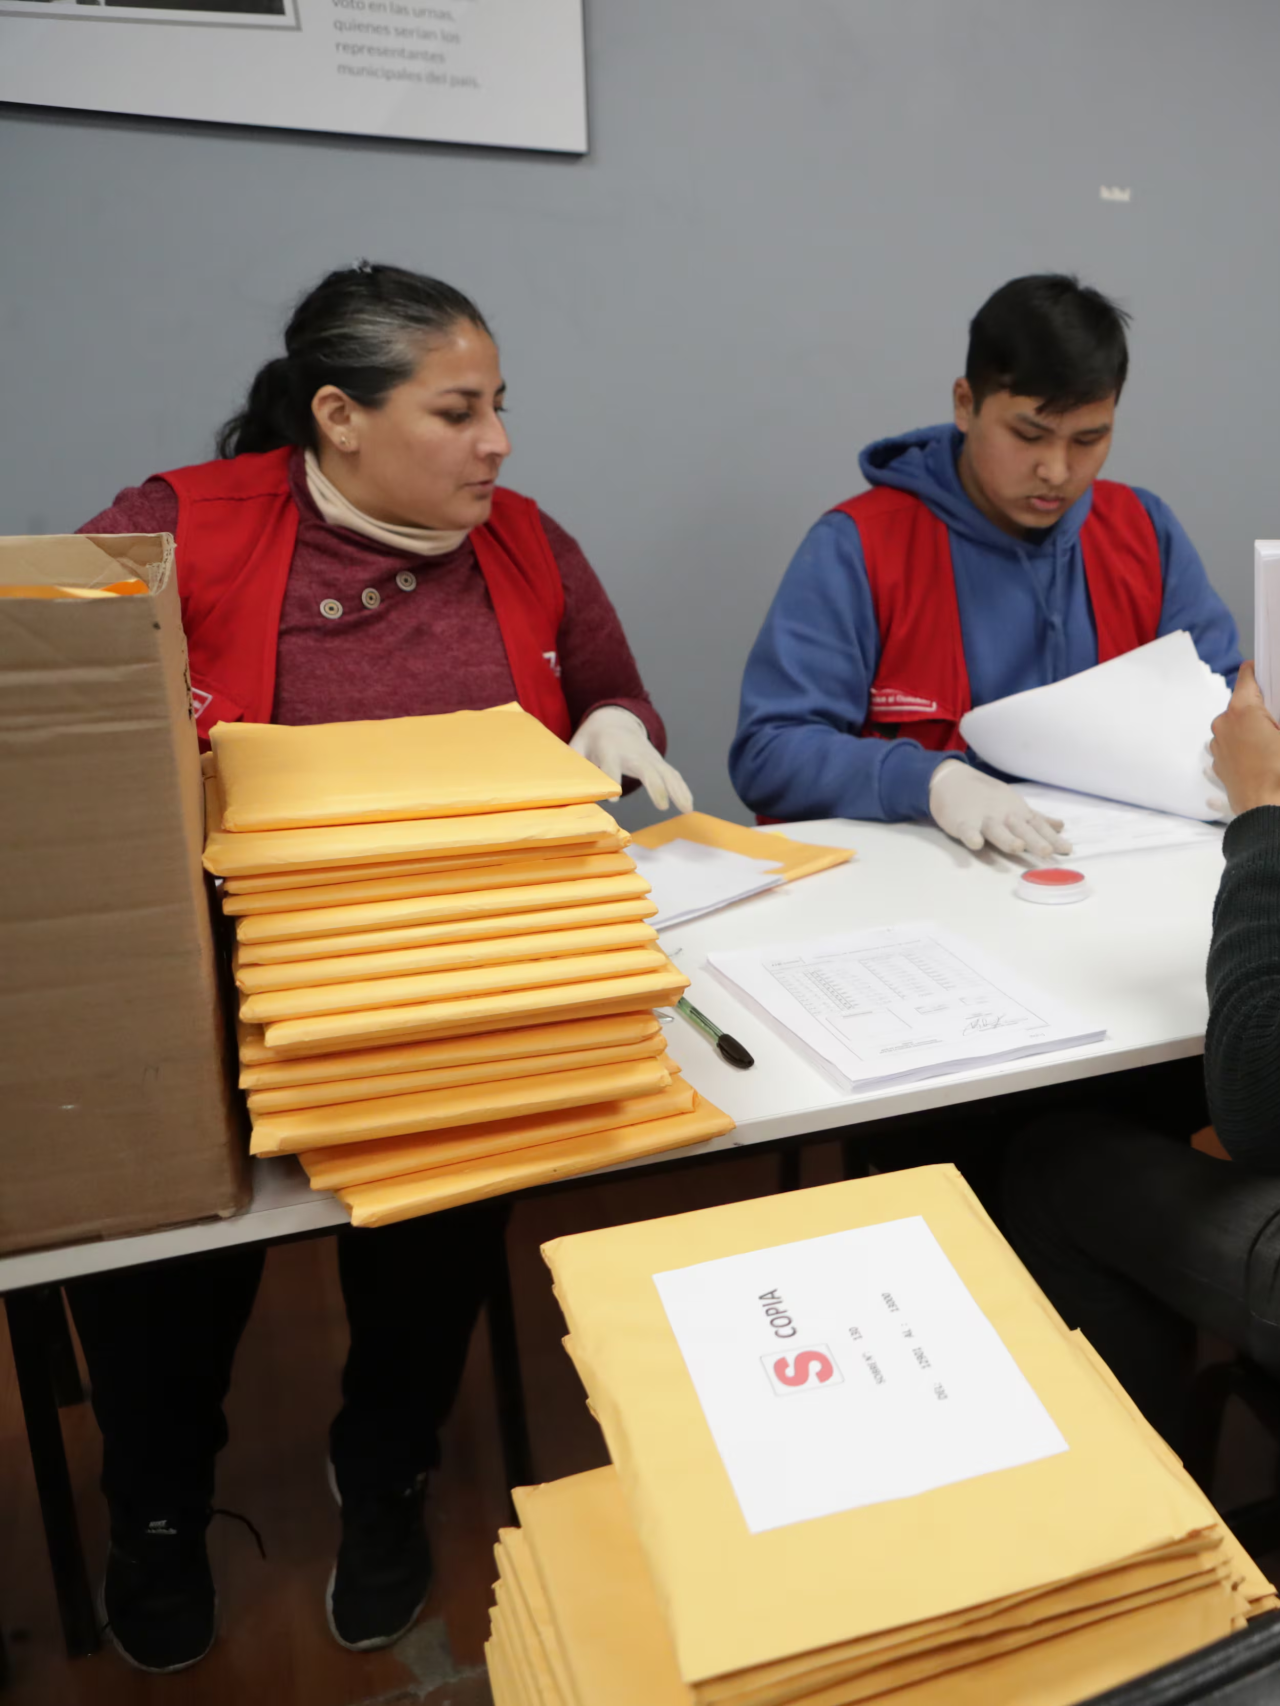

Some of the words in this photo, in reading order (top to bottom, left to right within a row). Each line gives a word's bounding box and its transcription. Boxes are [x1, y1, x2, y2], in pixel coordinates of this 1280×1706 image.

[368, 1, 387, 15] en
[389, 1, 411, 19] las
[332, 18, 391, 35] quienes
[440, 29, 460, 44] los
[335, 41, 446, 64] representantes
[337, 64, 423, 82] municipales
[425, 70, 447, 85] del
[758, 1288, 797, 1339] COPIA
[848, 1325, 863, 1341] 130
[773, 1349, 834, 1387] S
